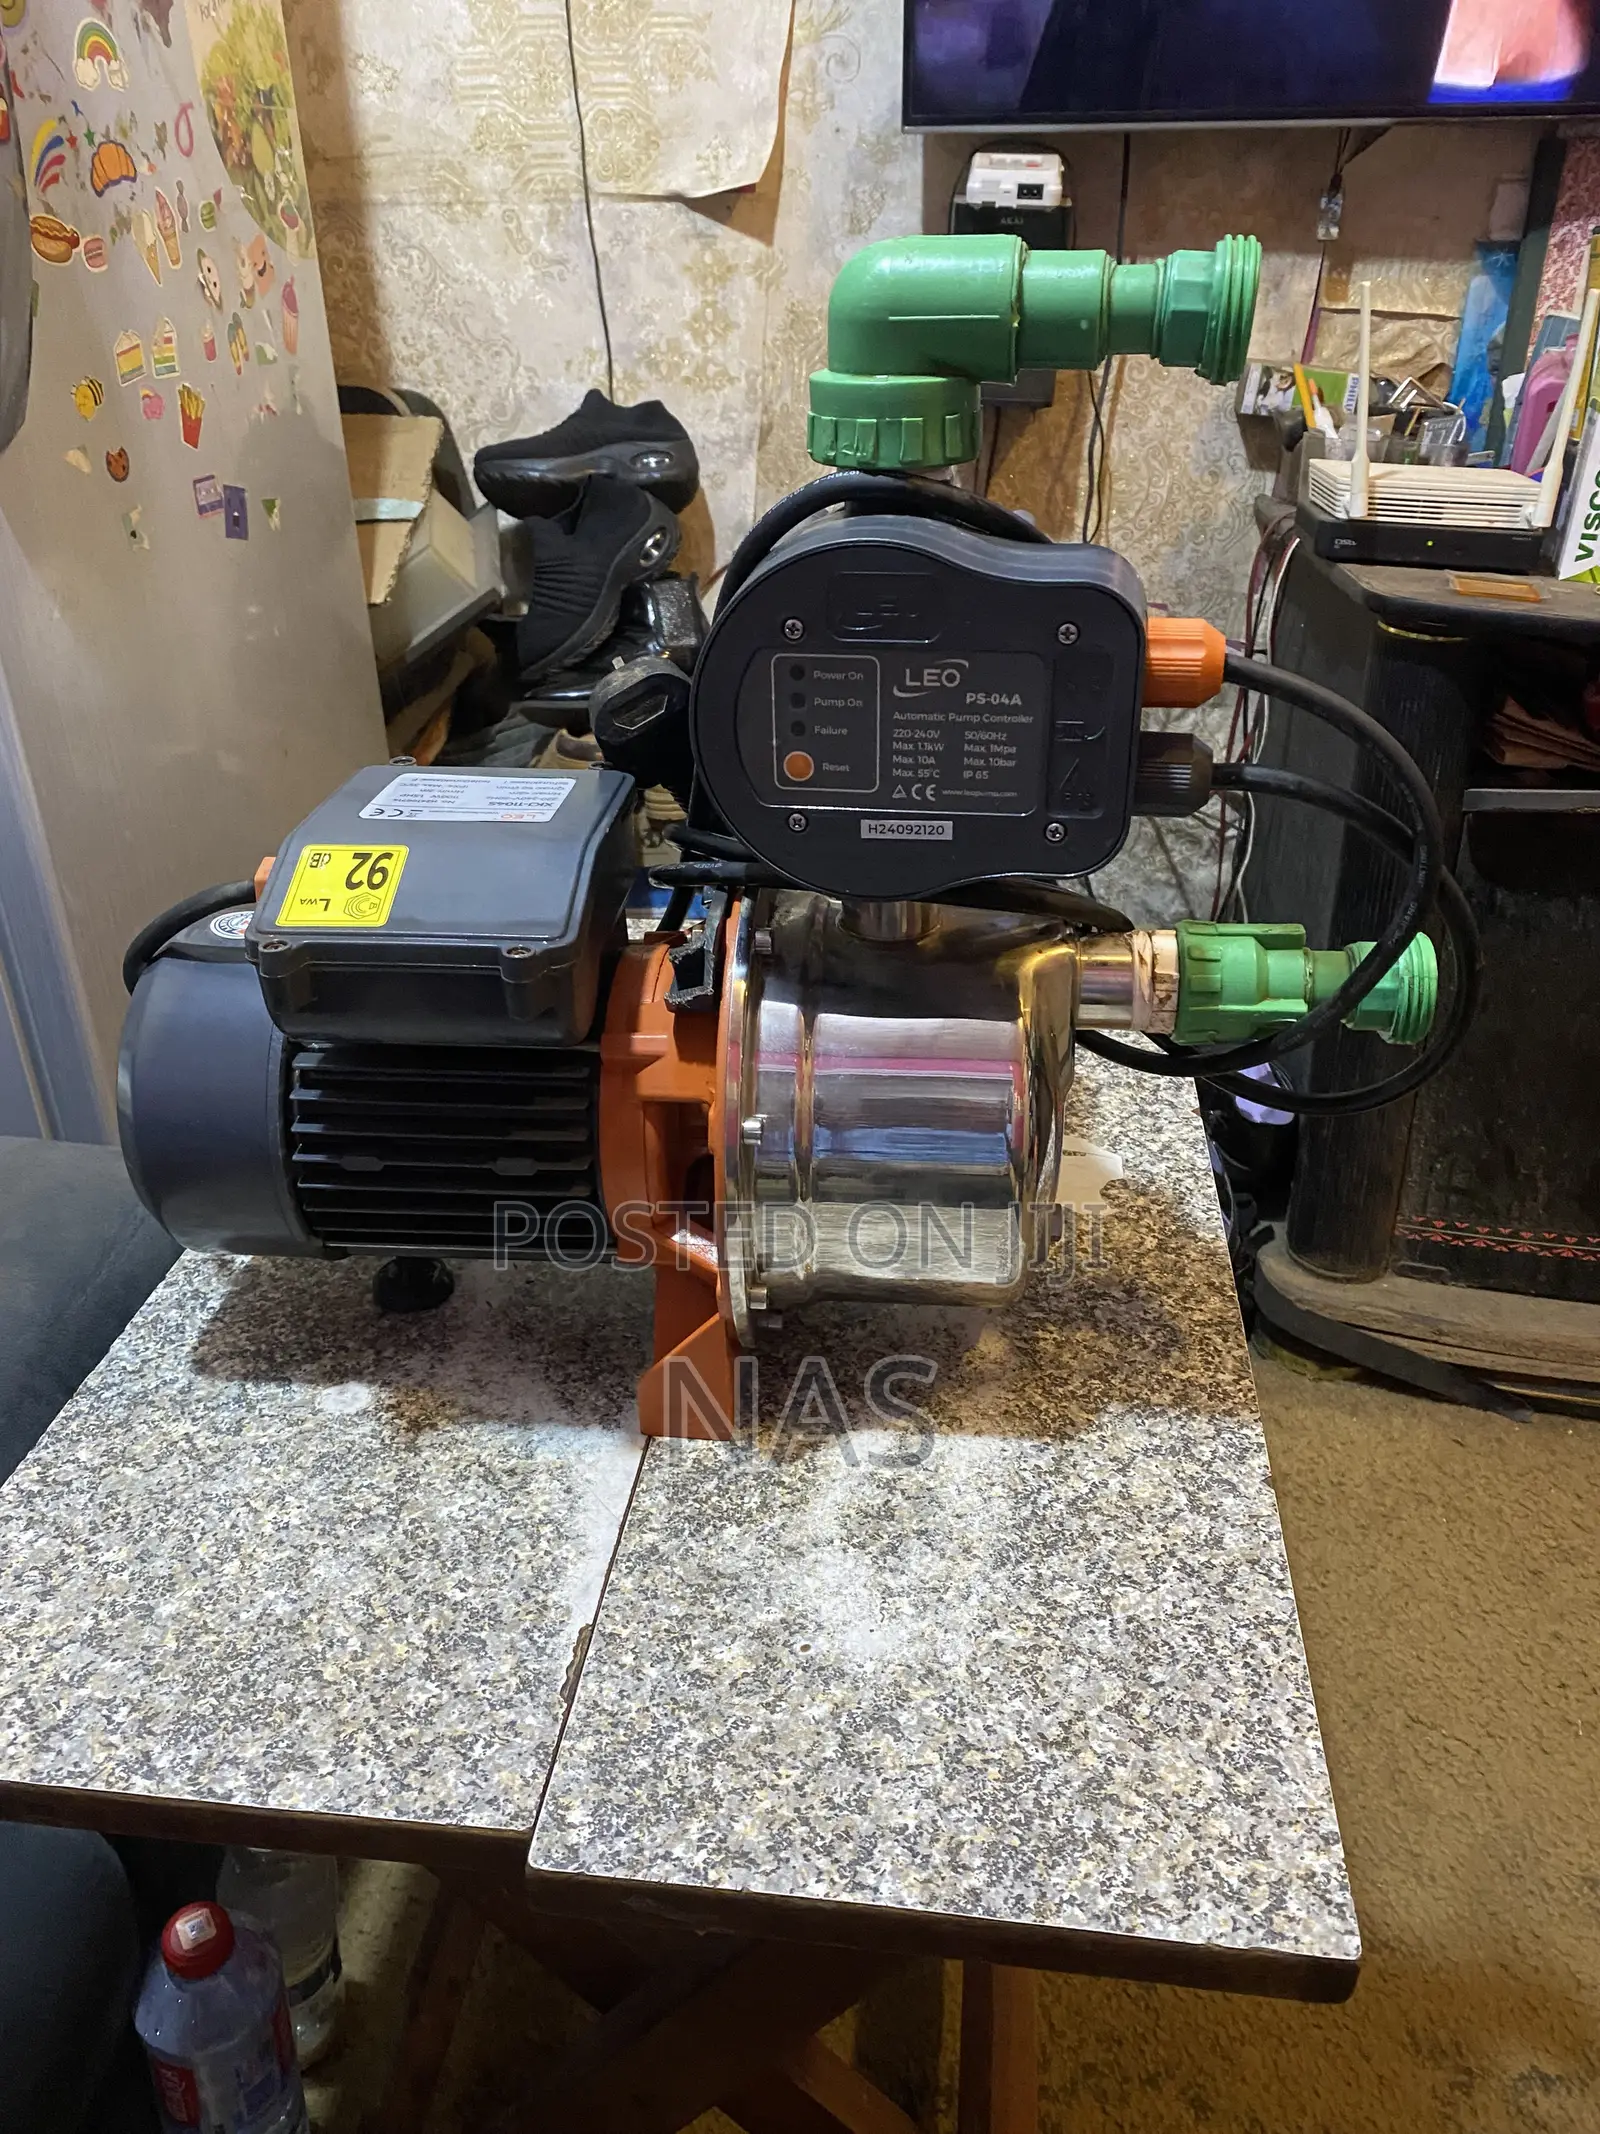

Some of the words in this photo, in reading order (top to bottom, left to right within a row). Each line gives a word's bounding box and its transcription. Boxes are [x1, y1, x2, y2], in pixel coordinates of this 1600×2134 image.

[1574, 469, 1600, 562] VISC
[813, 670, 846, 681] Power
[847, 671, 864, 681] On
[905, 667, 961, 688] LEO
[814, 697, 846, 708] Pump
[847, 698, 864, 708] On
[965, 692, 1023, 705] PS-04A
[892, 711, 947, 722] Automatic
[948, 712, 981, 724] Pump
[982, 713, 1034, 724] Controller
[814, 725, 849, 736] Failure
[892, 728, 941, 740] 220-240V
[964, 730, 1008, 741] 50/60Hz
[917, 755, 937, 765] 10A
[989, 757, 1018, 768] 10bar
[822, 762, 851, 773] Reset
[963, 770, 974, 779] IP
[975, 770, 990, 780] 65
[868, 824, 945, 836] H24092120
[309, 852, 332, 869] dB
[345, 852, 394, 890] 92
